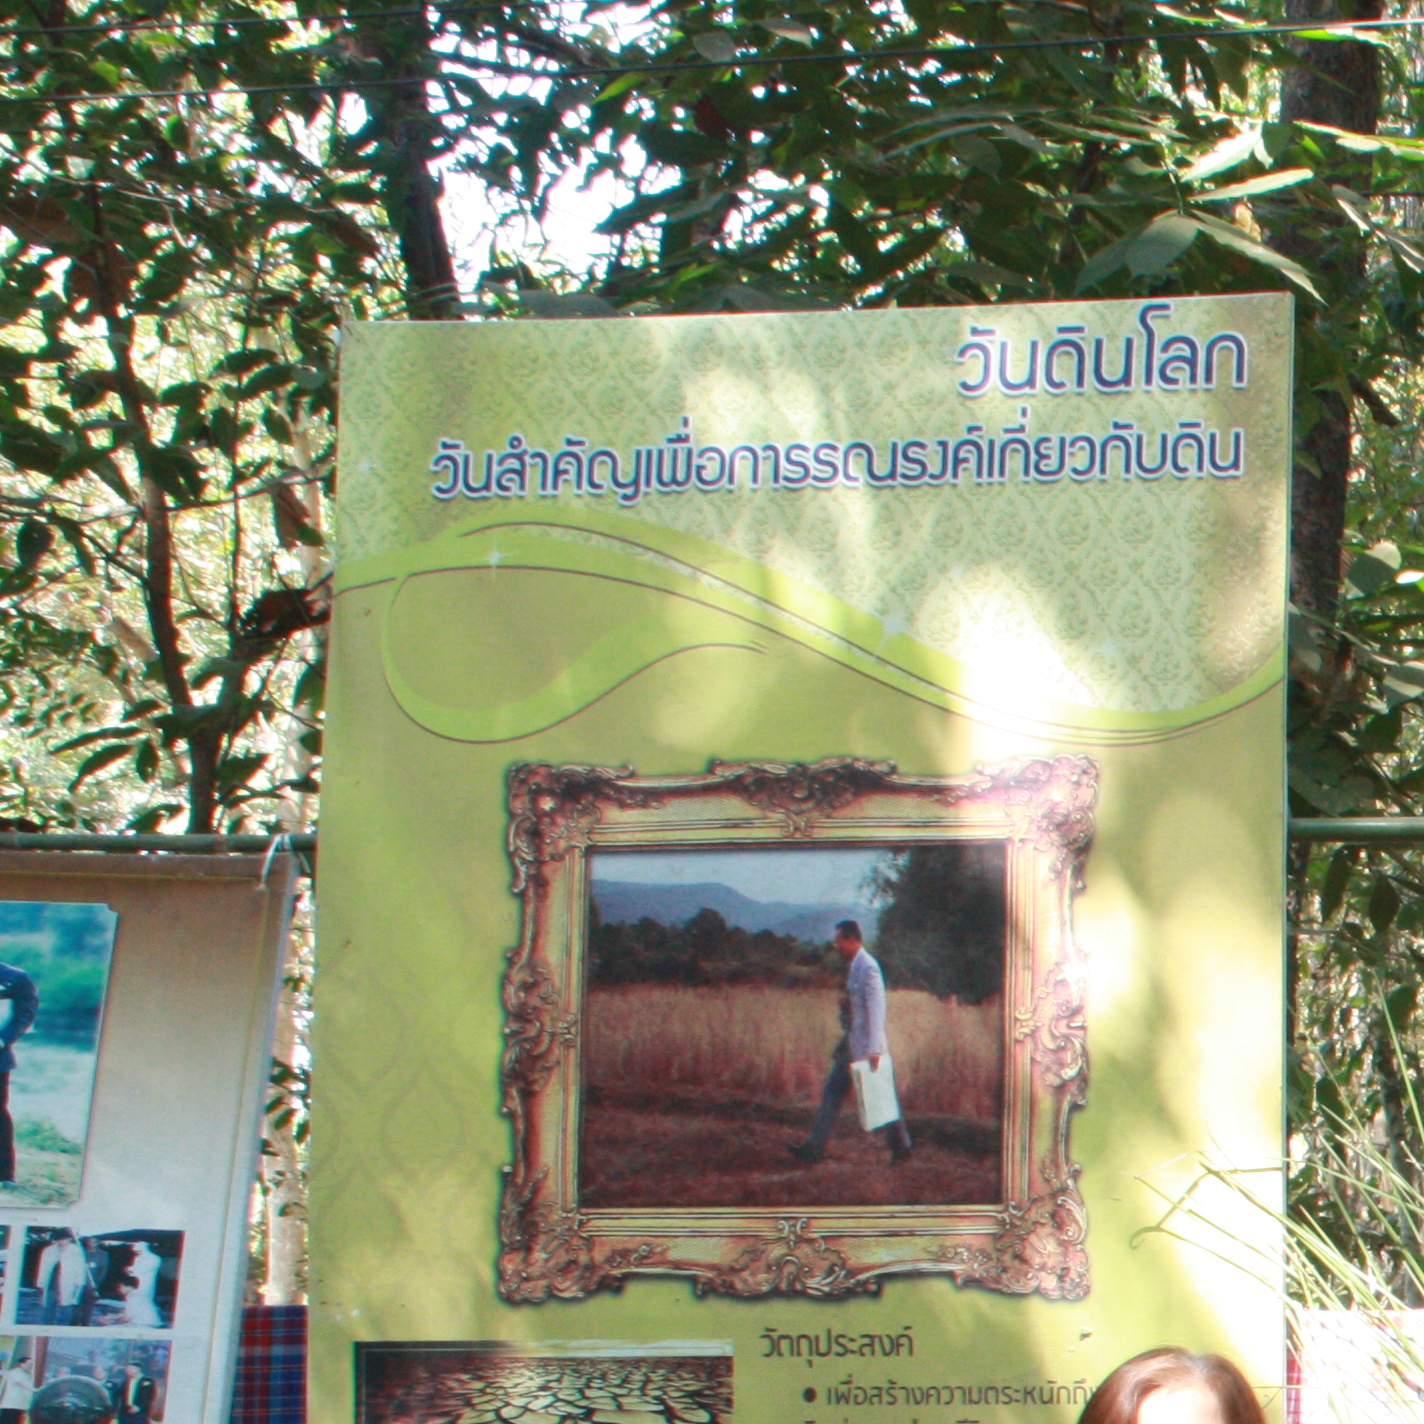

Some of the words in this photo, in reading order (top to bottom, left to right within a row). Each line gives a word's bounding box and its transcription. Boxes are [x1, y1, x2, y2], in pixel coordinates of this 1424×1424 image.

[956, 303, 1250, 396] วันดินโลก
[430, 406, 1244, 505] วันสำคัญเพื่อการรณรงค์เกี่ยวกับดิน
[762, 1326, 914, 1368] วัตถุประสงค์
[827, 1375, 1096, 1407] เพื่อสร้างความตระหนักถึ
